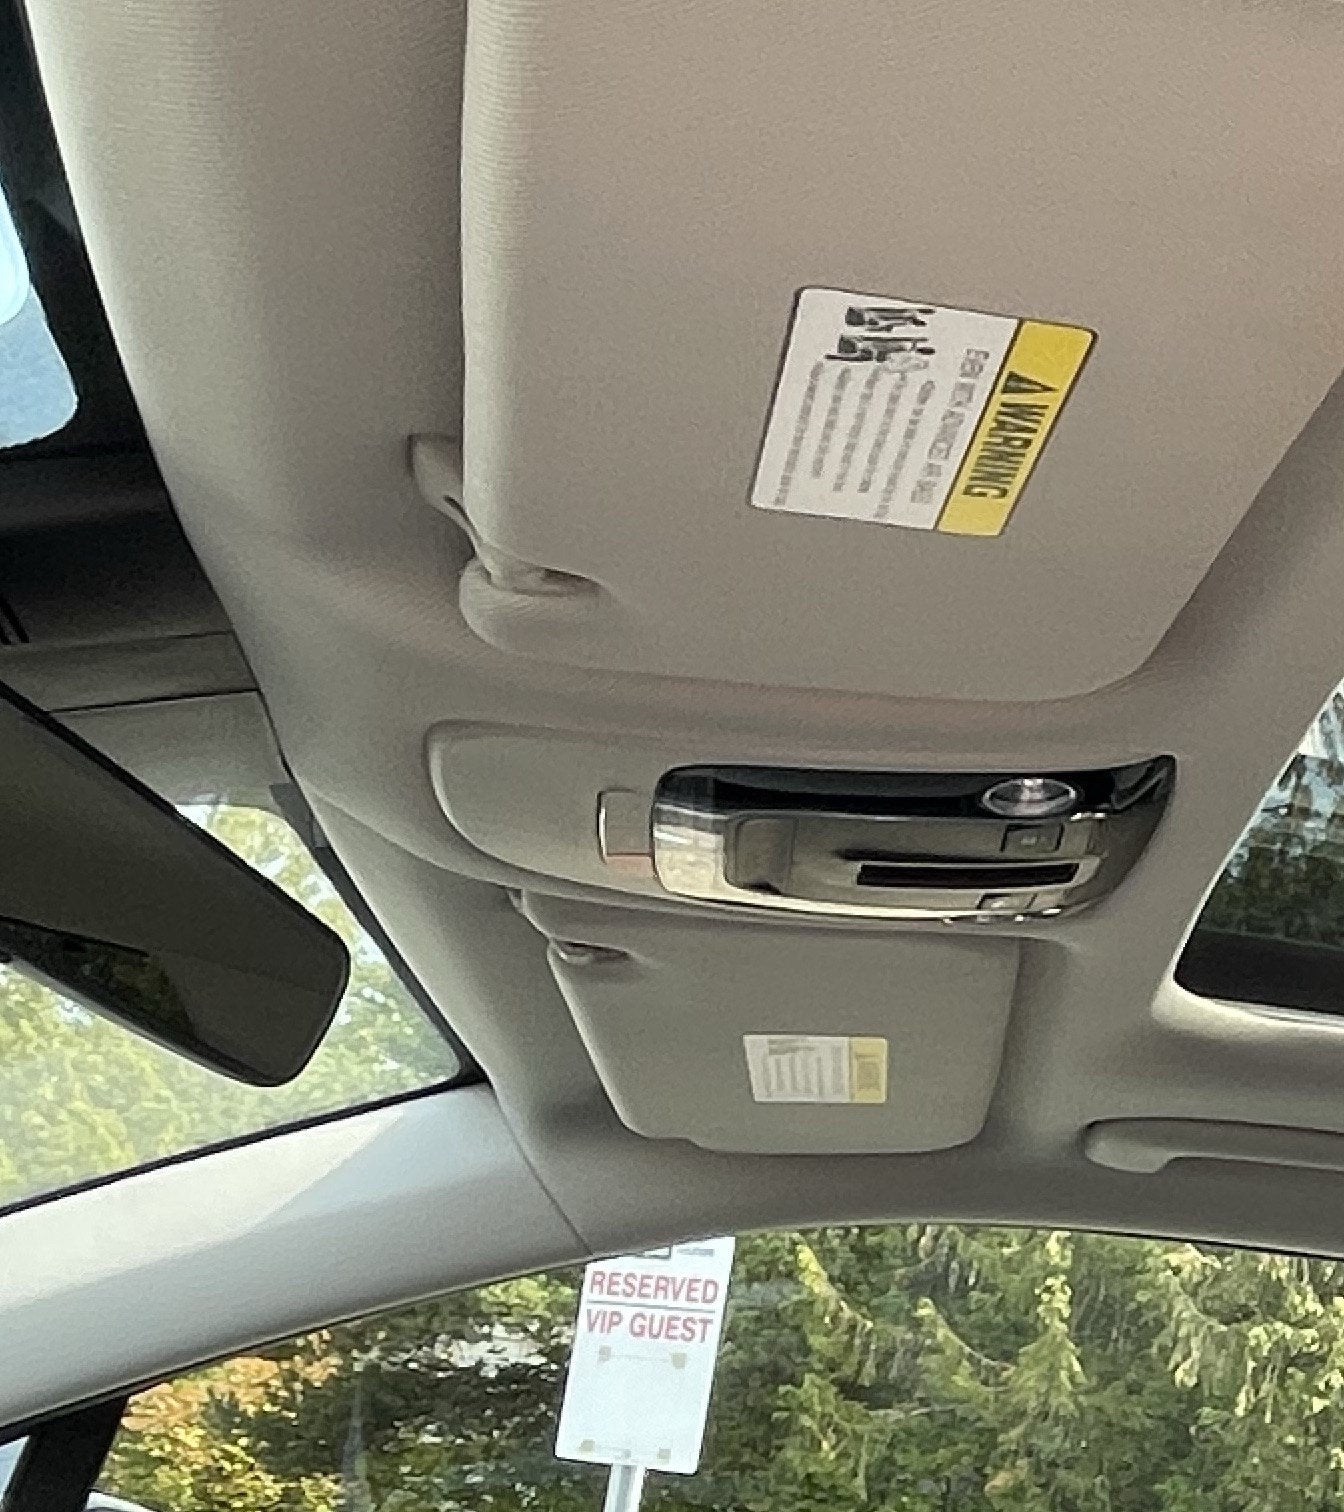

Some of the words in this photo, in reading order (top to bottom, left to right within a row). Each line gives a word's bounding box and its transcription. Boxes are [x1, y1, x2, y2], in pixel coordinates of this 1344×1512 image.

[962, 402, 1050, 500] WARNING
[589, 1270, 719, 1304] RESERVED
[586, 1308, 623, 1335] VIP
[629, 1312, 714, 1343] GUEST
